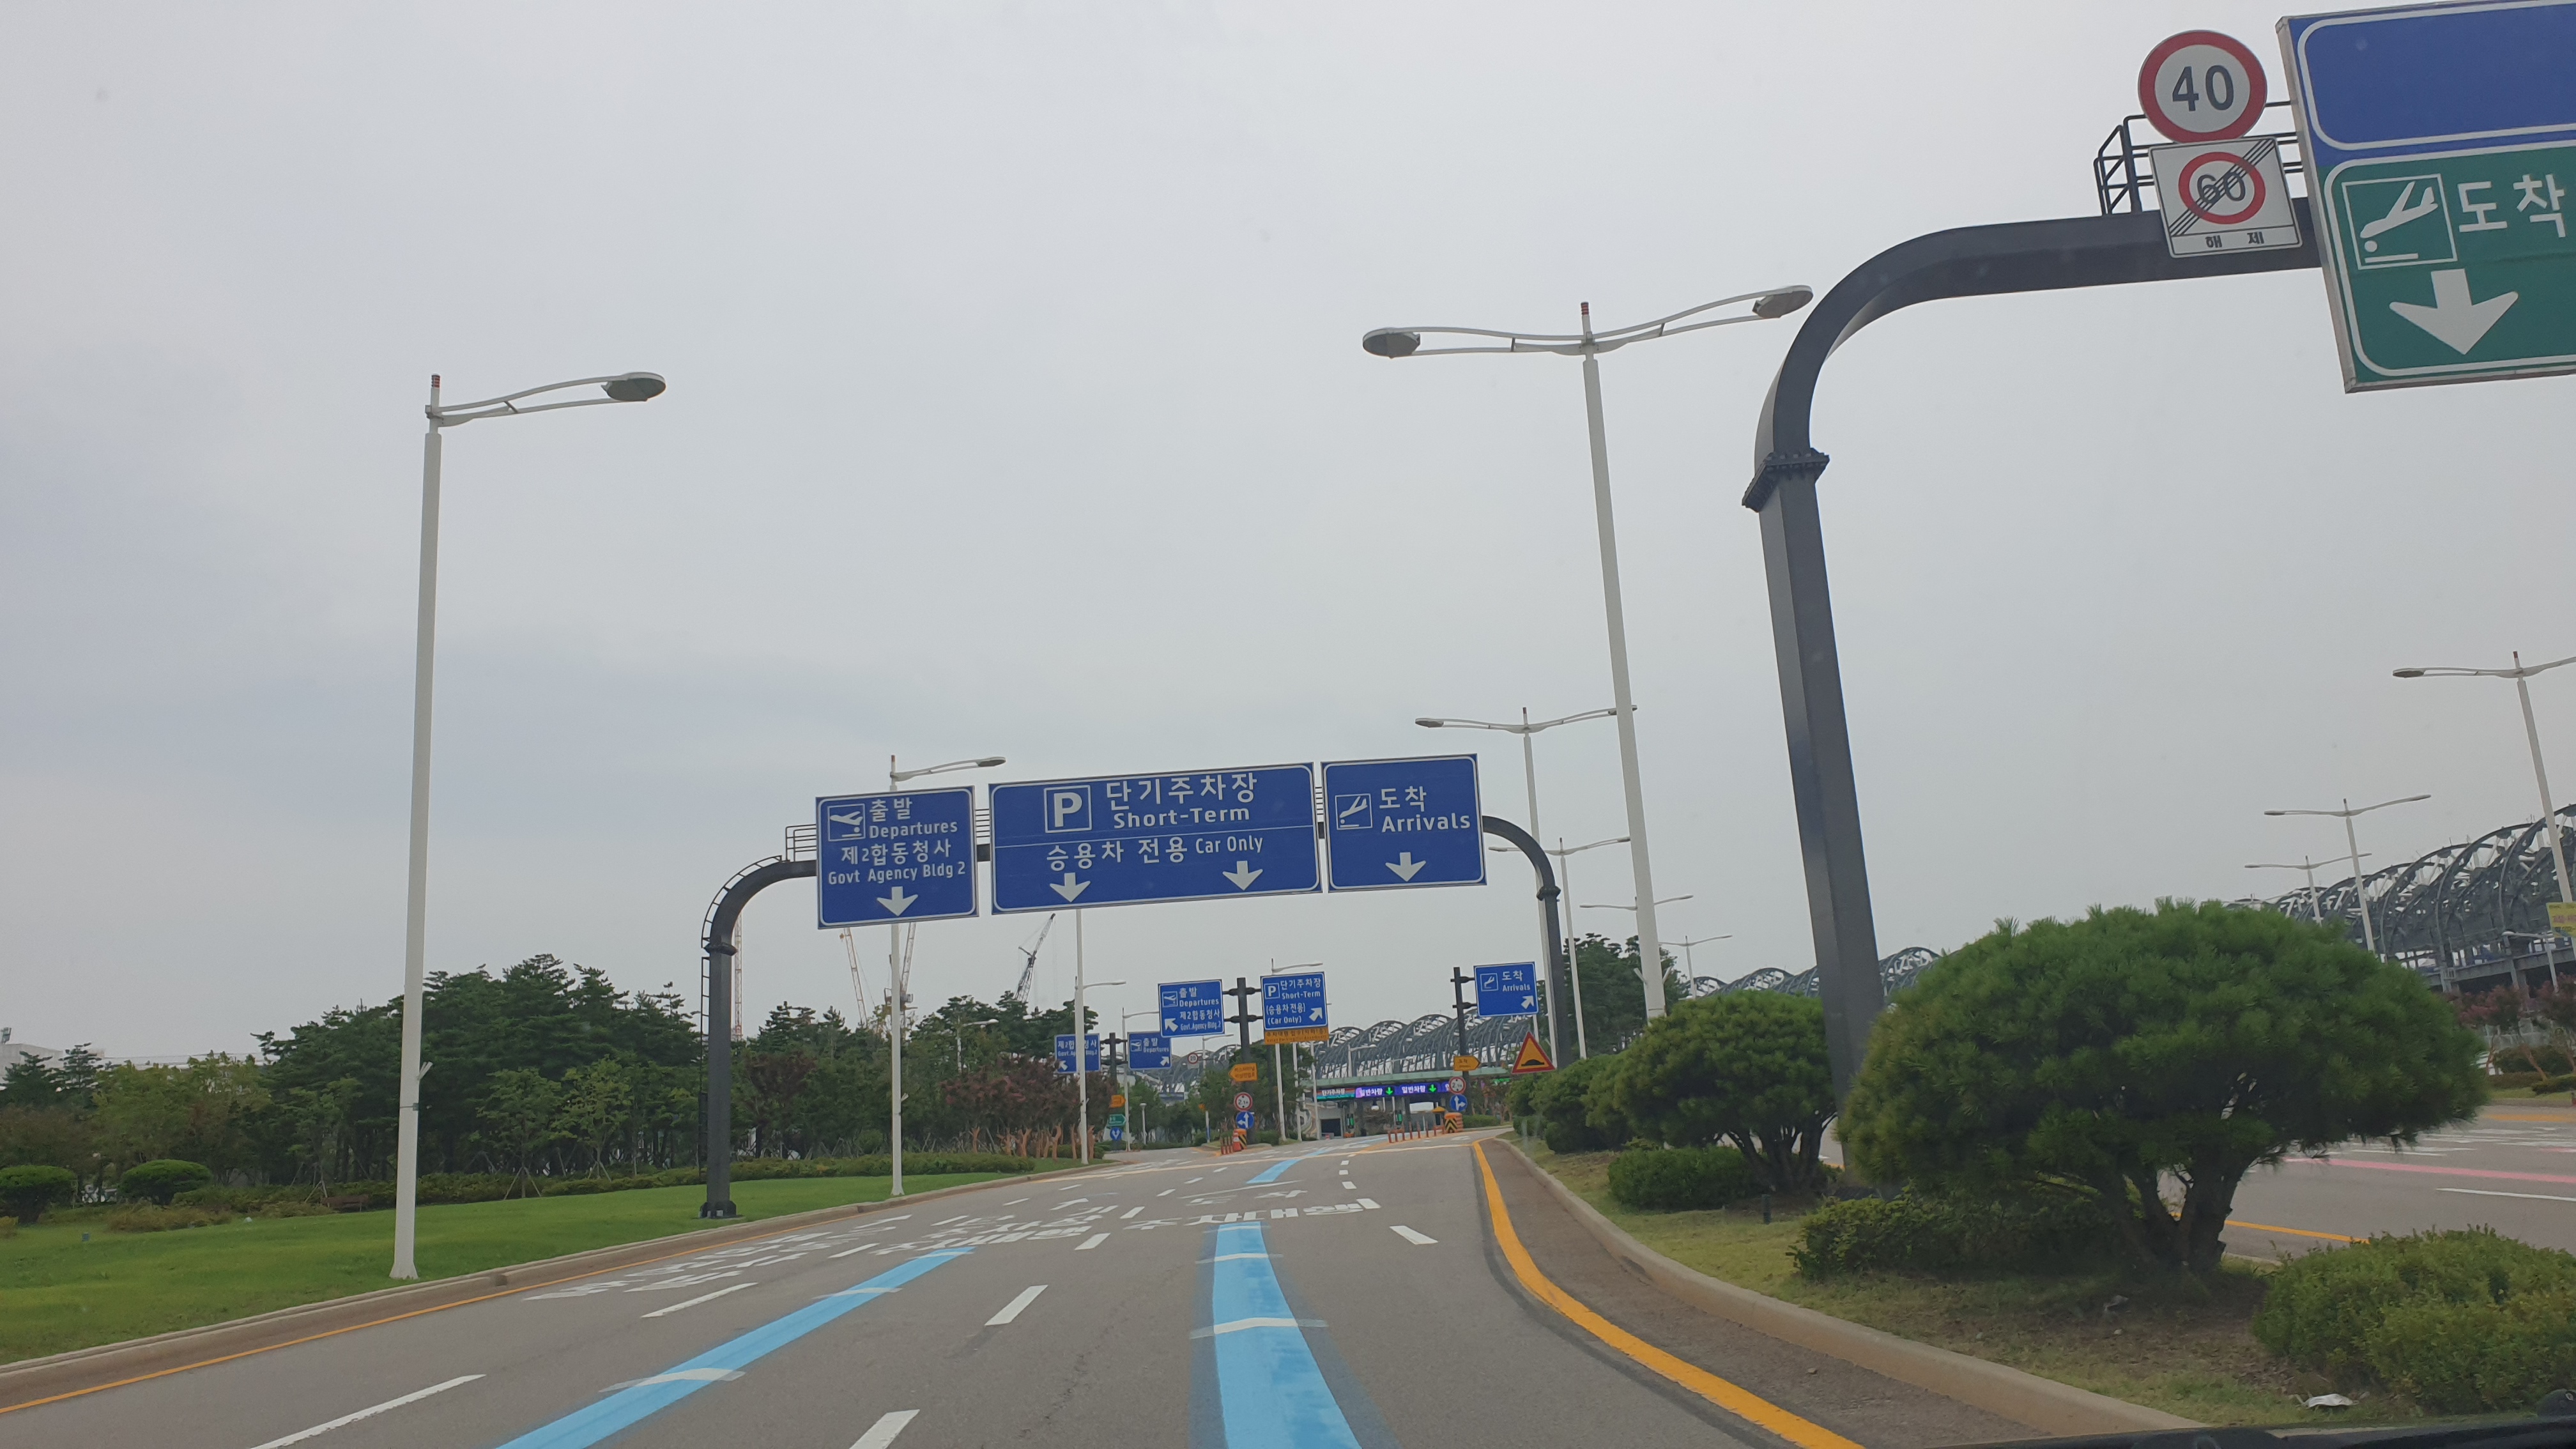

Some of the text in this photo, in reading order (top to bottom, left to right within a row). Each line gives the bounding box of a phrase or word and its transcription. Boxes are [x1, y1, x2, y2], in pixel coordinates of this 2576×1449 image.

[2172, 65, 2234, 111] 40
[2197, 171, 2246, 204] 60
[2457, 174, 2566, 238] 도착
[1107, 772, 1257, 811] 단기주차장
[1379, 786, 1427, 812] 도착
[870, 797, 912, 822] 출발
[1054, 792, 1083, 827] P
[1114, 808, 1250, 829] Short-Term
[870, 822, 958, 839] Departures
[1381, 813, 1470, 832] Arrivals
[841, 838, 951, 866] 제2합동청사
[1046, 834, 1263, 871] 승용차 전용 Car Only
[828, 861, 966, 885] Govt Agency Bldg 2
[1280, 977, 1321, 990] 단기주차장
[1502, 970, 1523, 981] 도착
[1179, 986, 1197, 998] 출발
[1268, 985, 1276, 997] P
[1282, 991, 1321, 1000] Short-Term
[1503, 984, 1531, 992] Arrivals
[1179, 998, 1219, 1008] Departures
